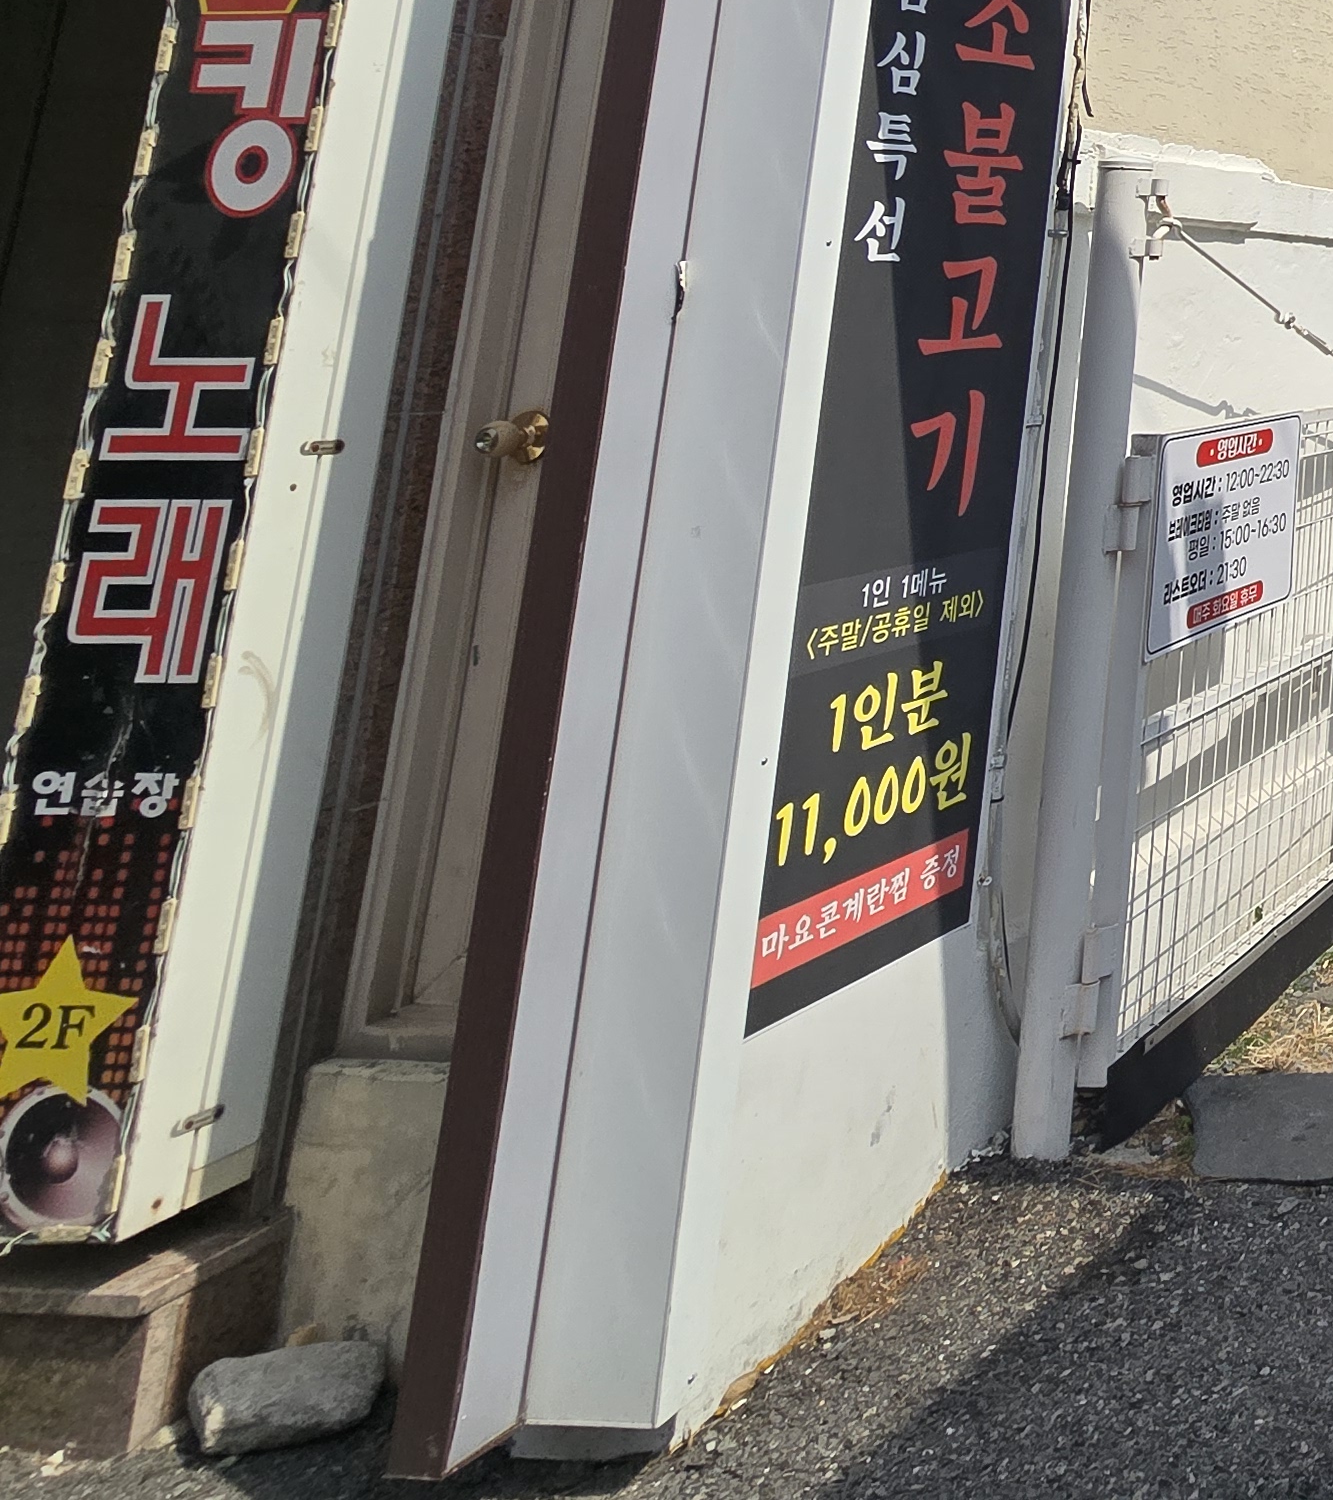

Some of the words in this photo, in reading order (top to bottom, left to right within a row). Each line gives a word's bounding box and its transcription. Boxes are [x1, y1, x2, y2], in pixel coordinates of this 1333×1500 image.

[1217, 433, 1258, 460] 영업시간
[1172, 476, 1216, 507] 영업시간
[1226, 459, 1290, 492] 12:00~22:30
[1222, 502, 1240, 523] 주말
[1243, 496, 1260, 518] 없음
[1188, 534, 1210, 561] 평일
[861, 574, 892, 609] 1인
[901, 567, 948, 600] 1메뉴
[1163, 569, 1207, 605] 라스트오더
[1216, 556, 1247, 585] 21:30
[1212, 591, 1239, 616] 화요일
[1240, 584, 1258, 606] 휴무
[830, 659, 949, 754] 1인분
[31, 768, 180, 819] 연습장
[776, 734, 972, 868] 11,000원
[761, 863, 911, 961] 마요콘계란찜
[922, 841, 962, 893] 증정
[15, 1000, 96, 1050] 2F
